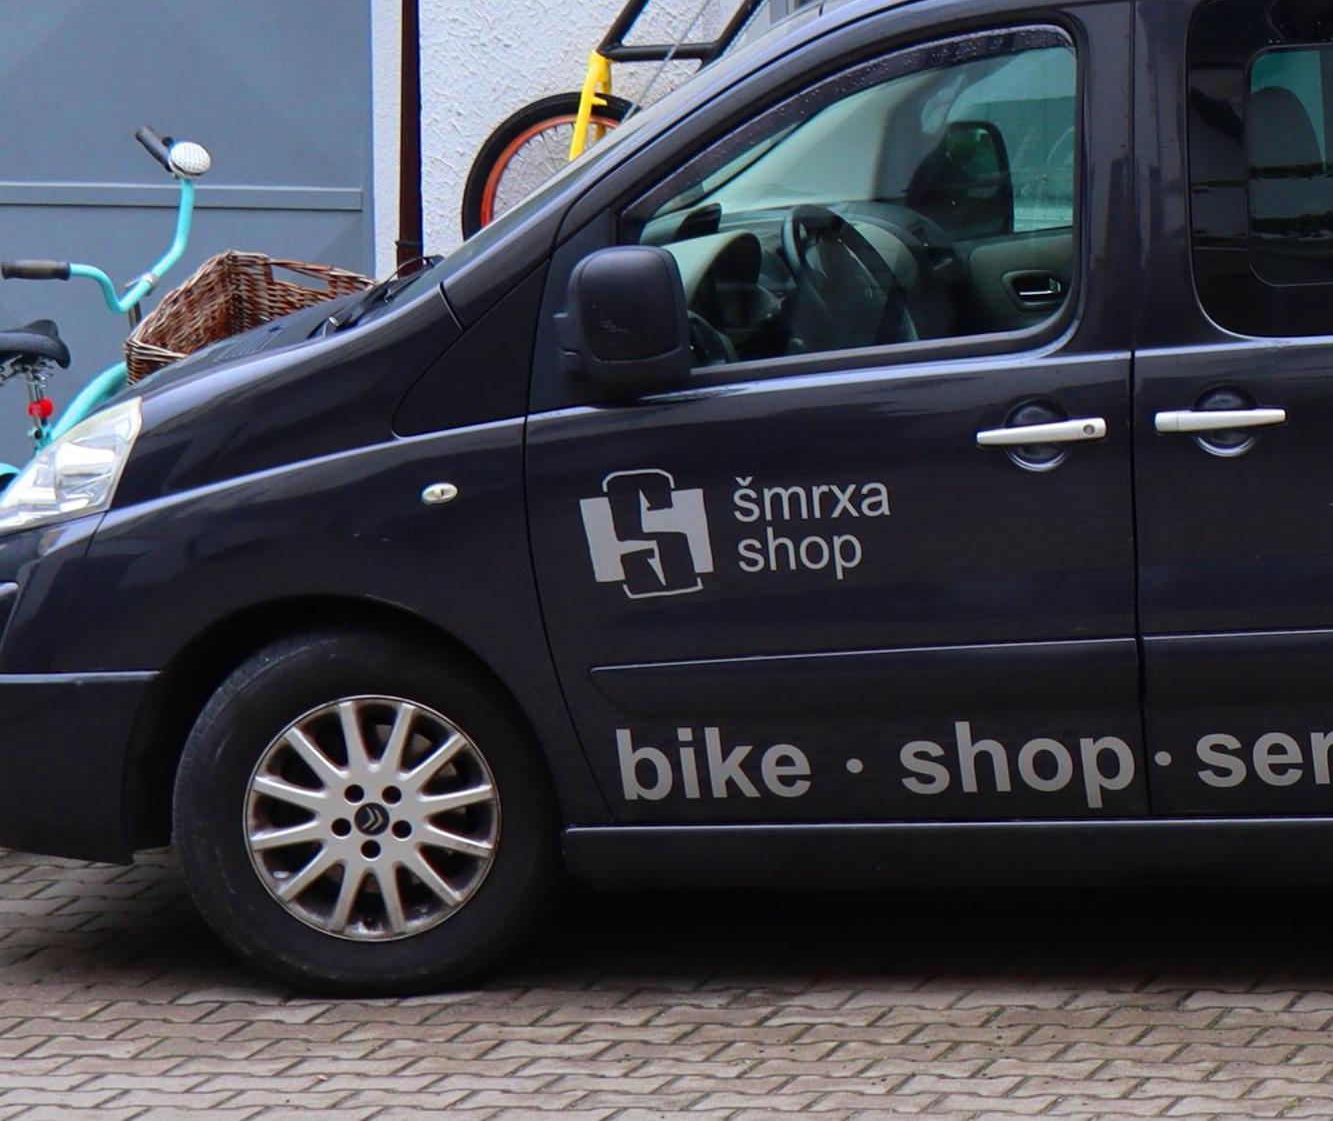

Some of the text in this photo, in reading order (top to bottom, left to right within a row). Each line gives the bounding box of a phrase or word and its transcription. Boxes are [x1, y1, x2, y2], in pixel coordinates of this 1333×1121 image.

[733, 476, 891, 523] šmrxa
[737, 526, 863, 580] shop
[615, 726, 812, 801] bike
[900, 721, 1135, 808] shop
